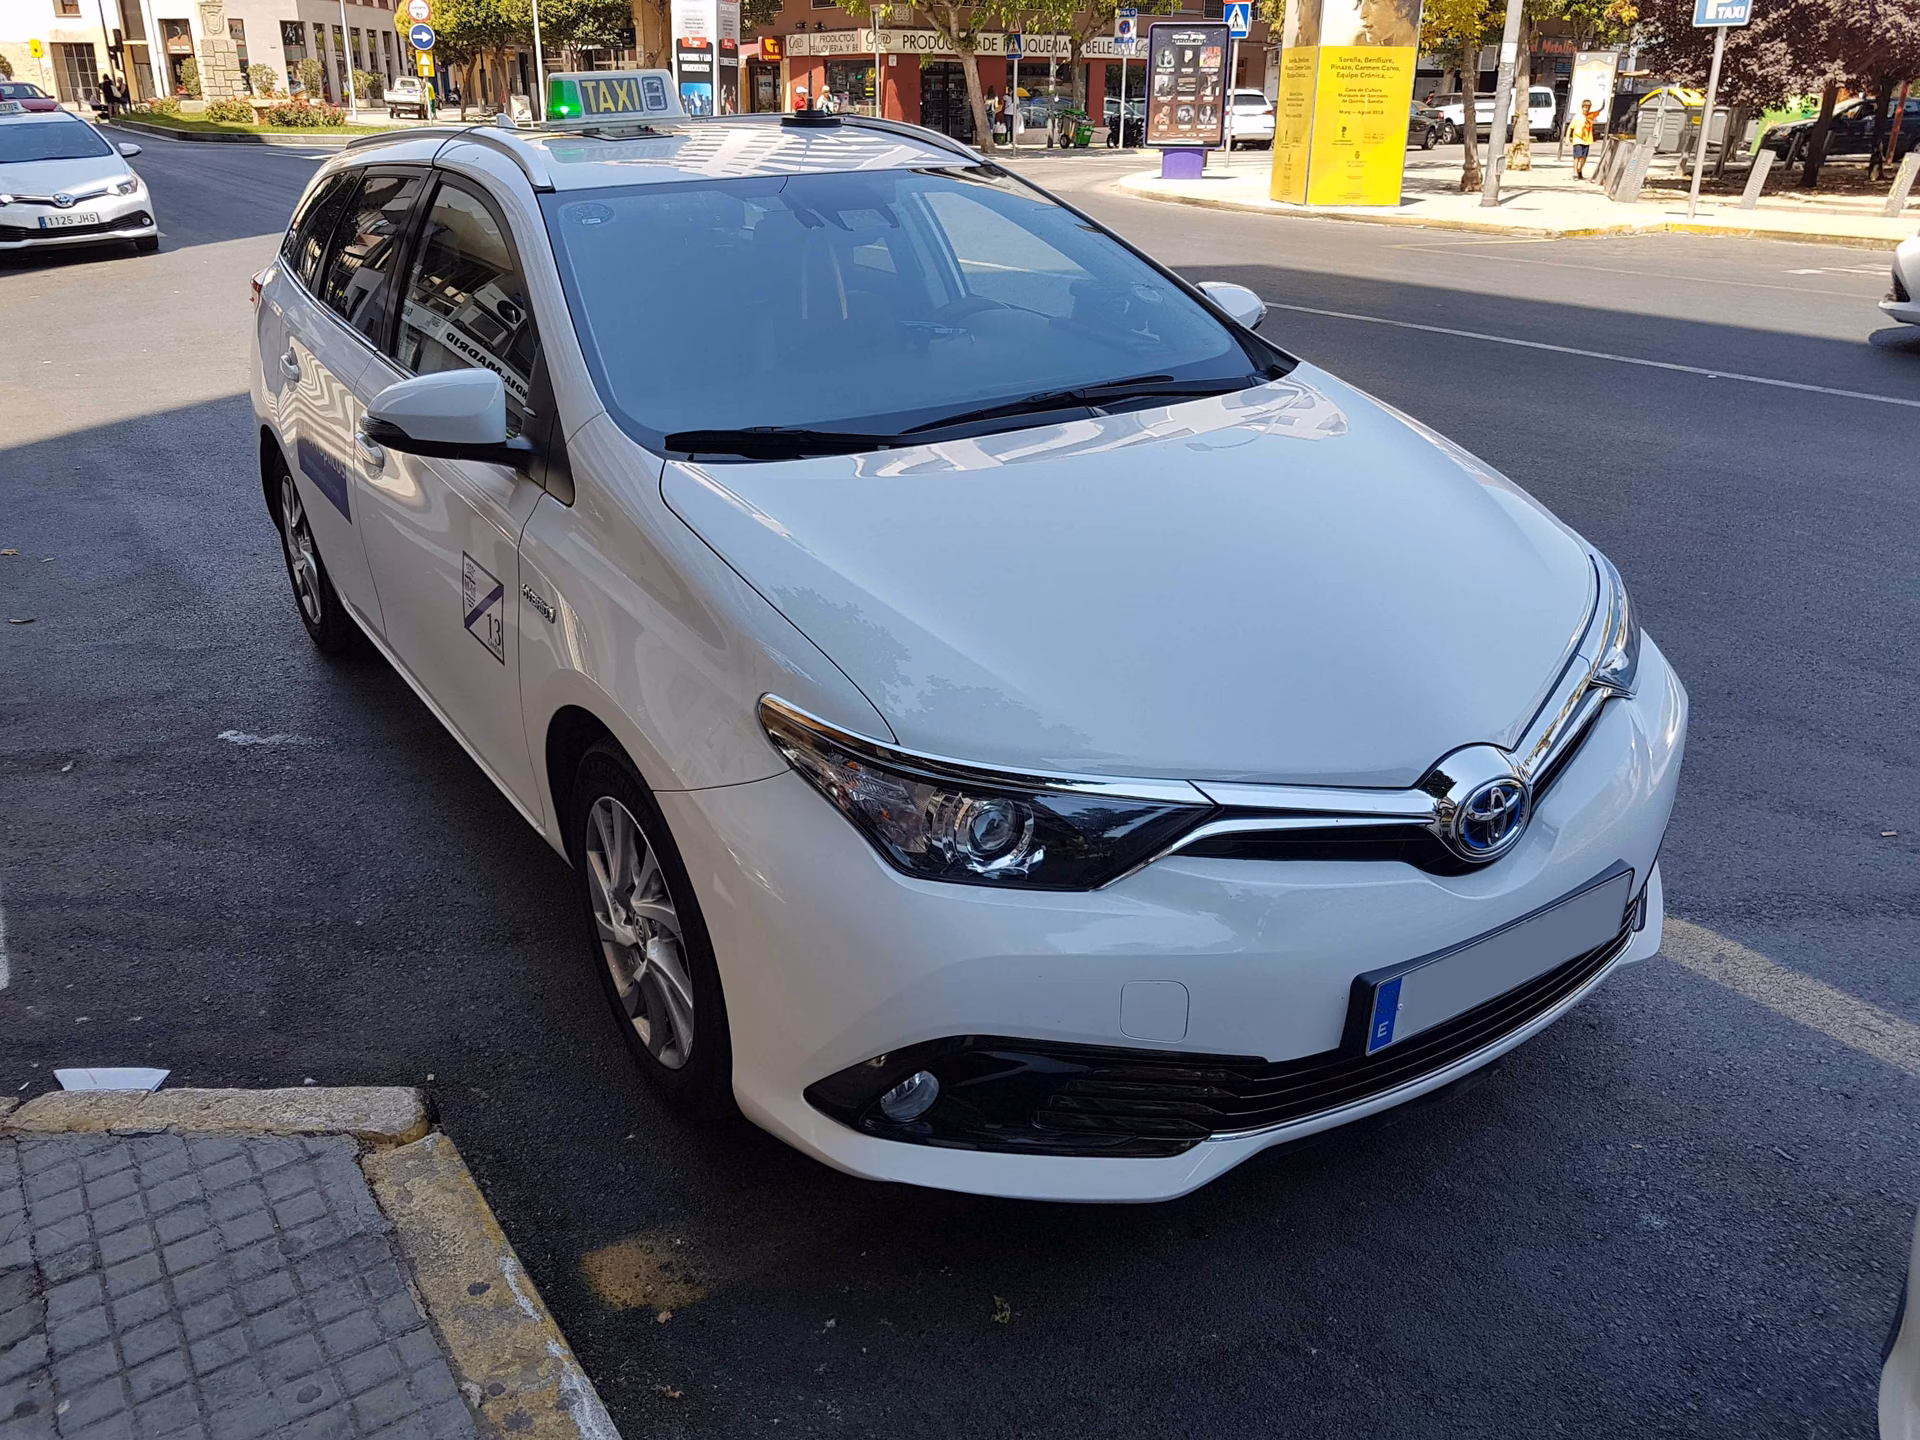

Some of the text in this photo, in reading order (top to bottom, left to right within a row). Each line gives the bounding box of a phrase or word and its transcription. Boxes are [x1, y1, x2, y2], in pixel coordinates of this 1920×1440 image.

[1717, 5, 1746, 19] TAXI
[819, 34, 855, 43] PRODUCTOS
[983, 37, 997, 51] DE
[1003, 38, 1069, 53] PUQUERIA
[1086, 41, 1112, 54] BELLE
[1364, 56, 1395, 64] Benlliure,
[1336, 71, 1359, 79] Equipo
[1360, 71, 1386, 79] Crónica,
[581, 79, 640, 113] TAXI
[48, 213, 96, 226] 1125 JHS
[486, 613, 502, 646] 13
[1377, 1020, 1389, 1038] E
